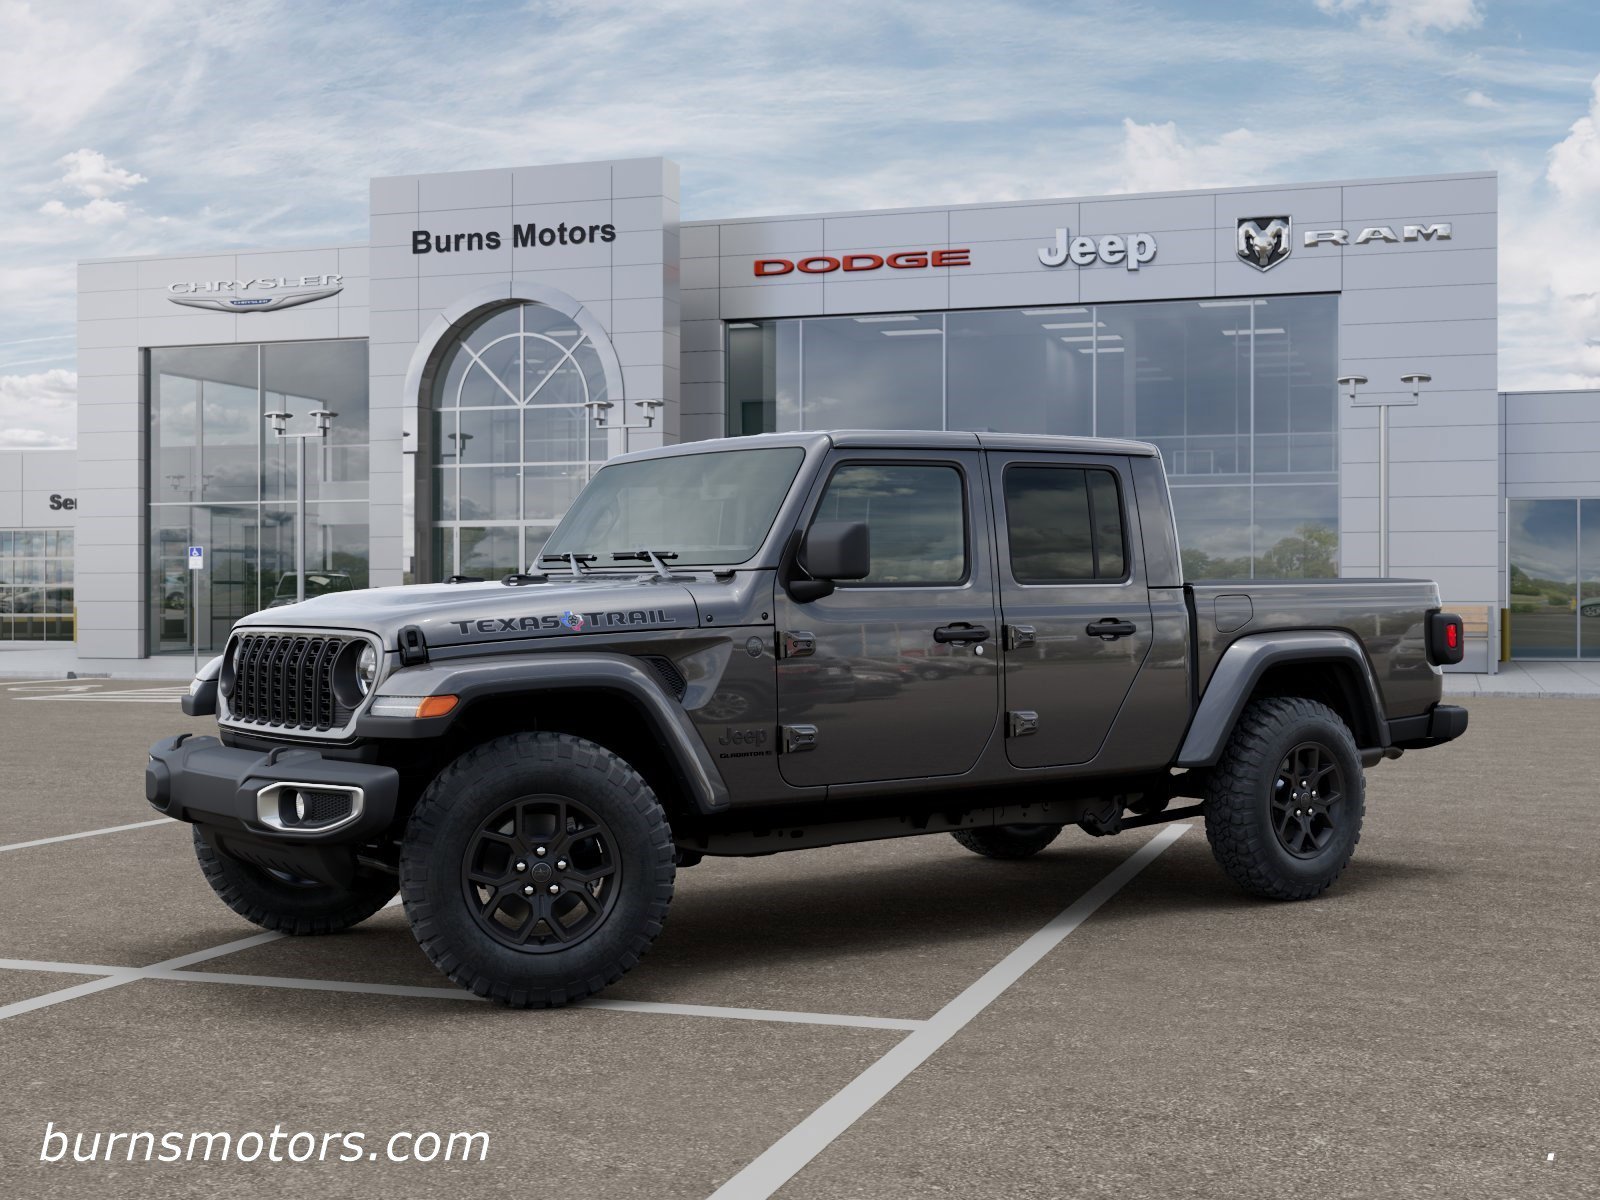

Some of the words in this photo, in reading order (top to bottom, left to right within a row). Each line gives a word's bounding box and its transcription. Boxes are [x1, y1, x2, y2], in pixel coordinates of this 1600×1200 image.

[411, 230, 502, 254] Burns
[513, 222, 617, 248] Motors
[1303, 222, 1453, 248] RAM
[754, 248, 971, 277] DODGE
[1037, 227, 1157, 272] Jeep
[167, 273, 344, 294] CHRYSLER
[450, 615, 560, 635] TEXAS
[583, 609, 676, 627] TRAIL
[718, 727, 768, 748] Jeep
[719, 750, 765, 759] GLADIATOR
